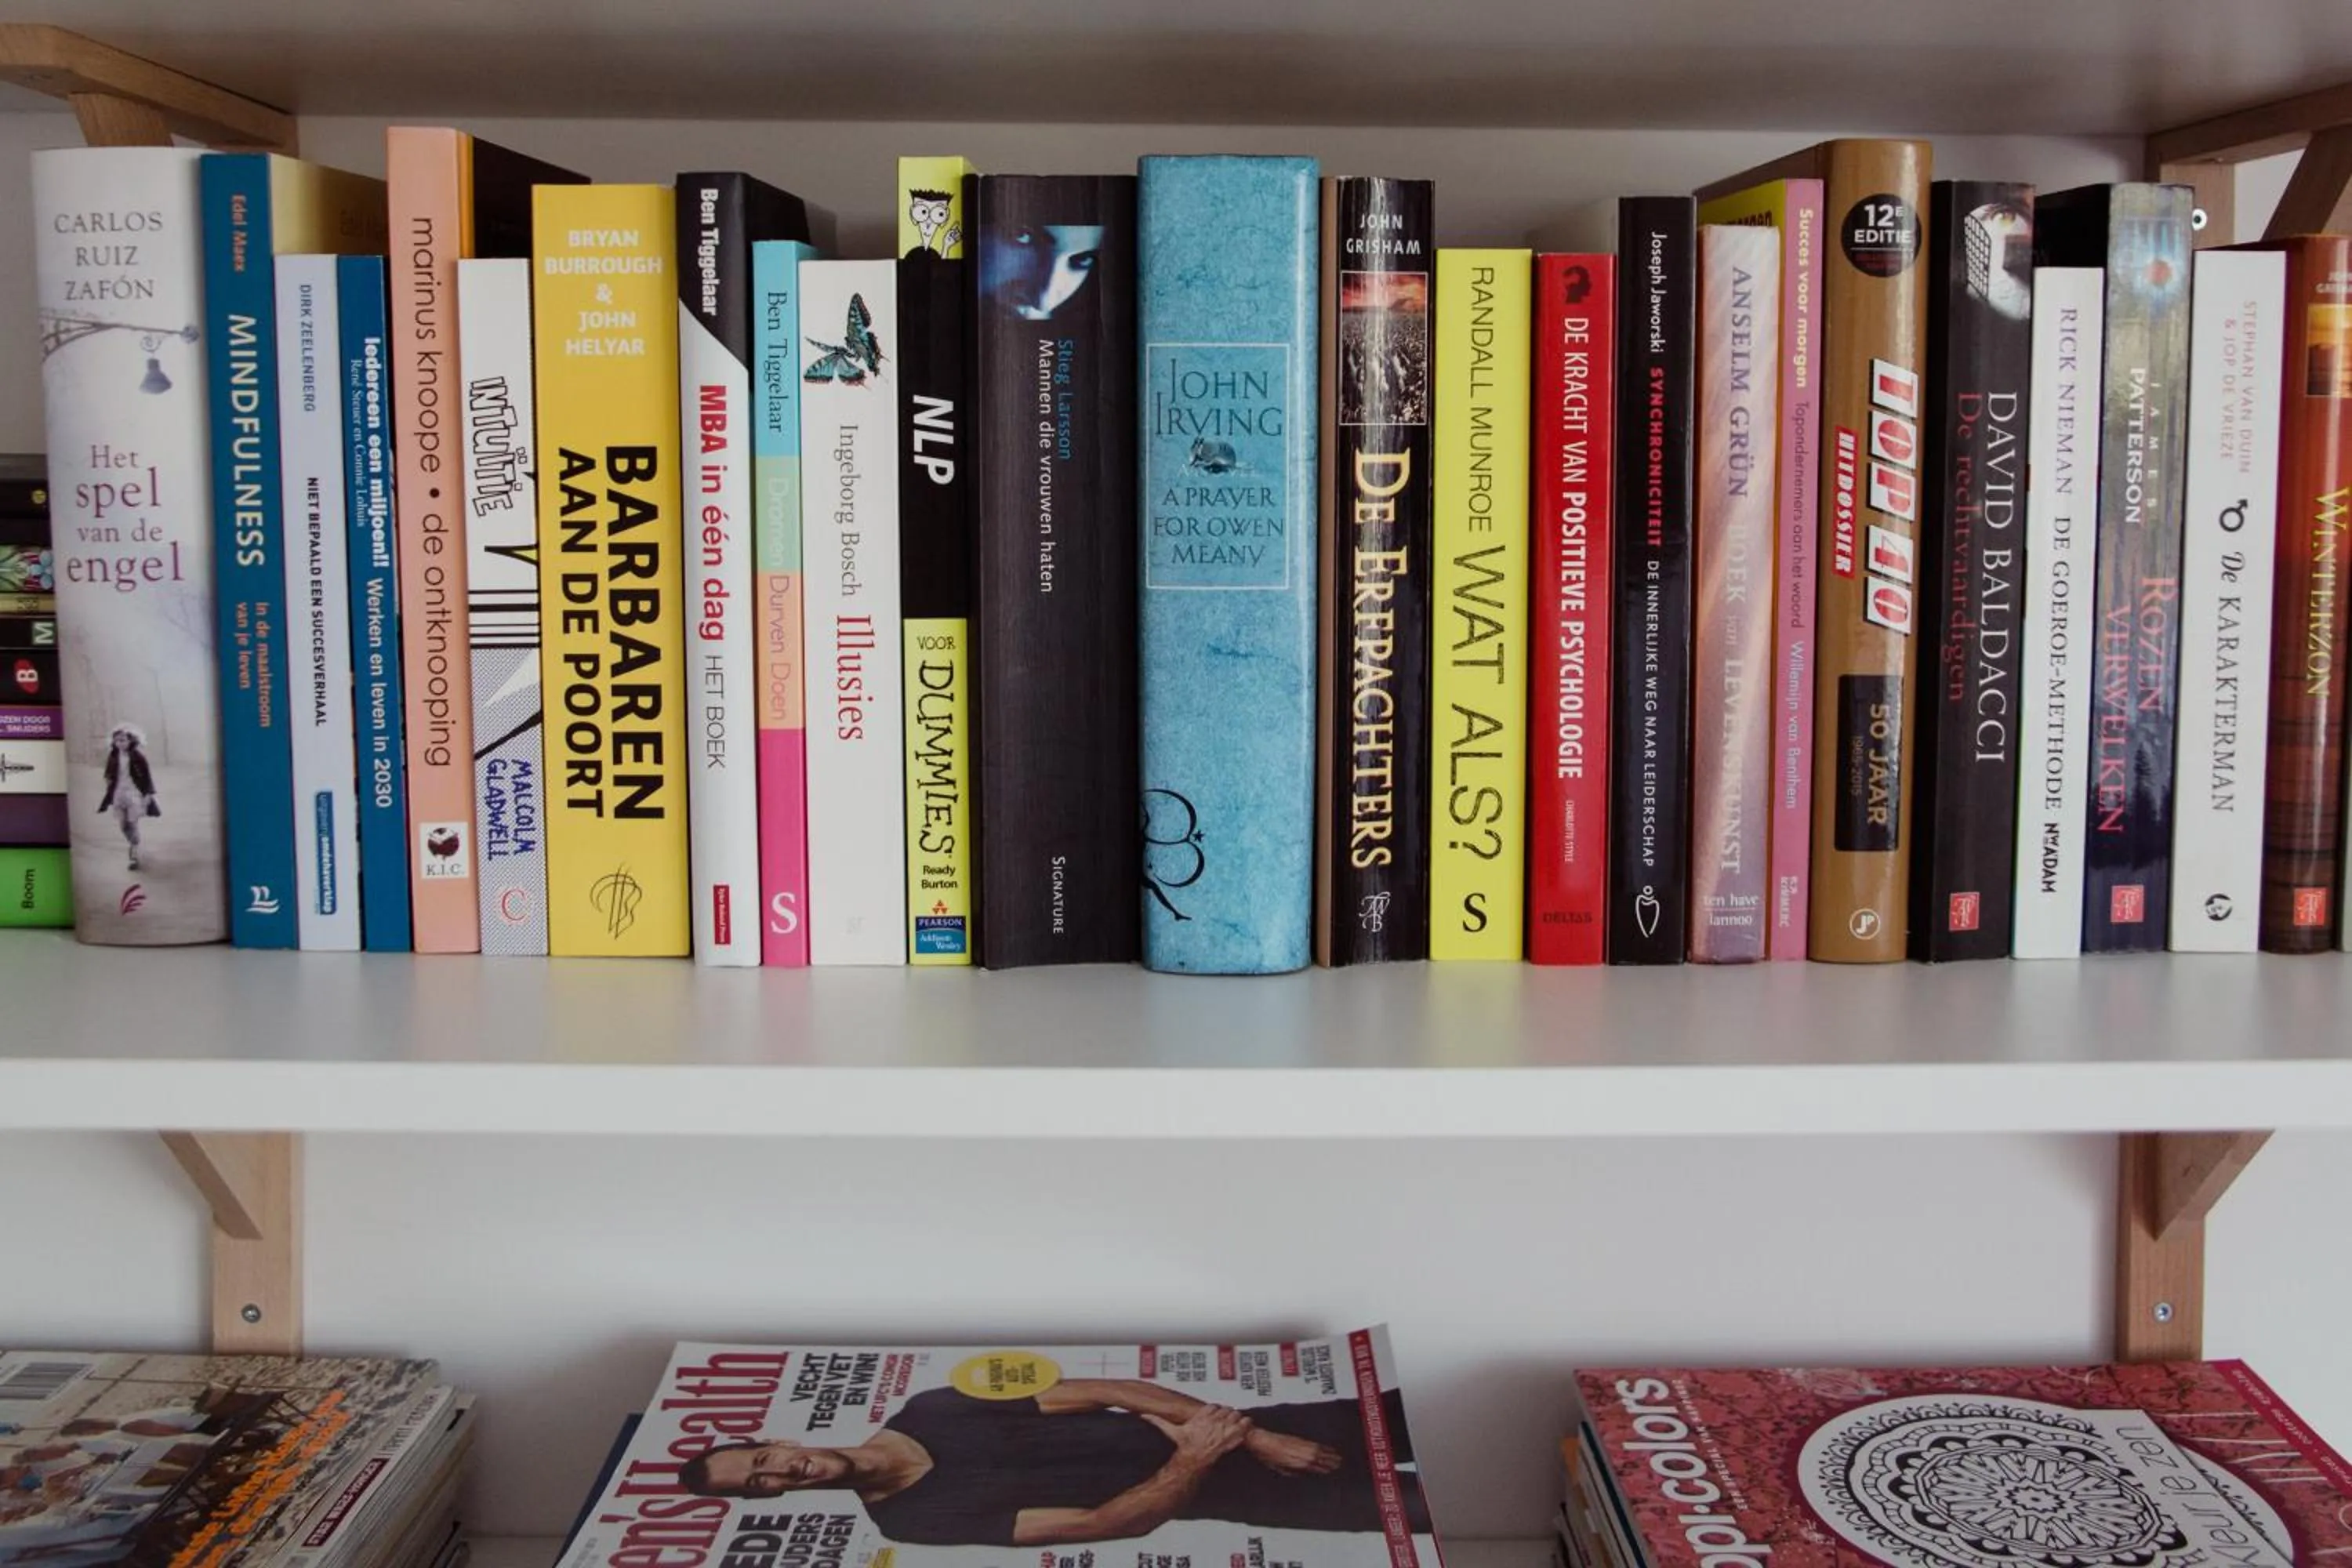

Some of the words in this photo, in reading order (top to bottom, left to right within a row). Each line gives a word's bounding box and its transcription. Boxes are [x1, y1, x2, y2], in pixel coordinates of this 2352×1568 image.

[54, 211, 164, 234] CARLOS
[700, 188, 719, 224] Ben
[1360, 214, 1403, 230] JOHN
[76, 245, 140, 267] RUIZ
[568, 230, 639, 247] BRYAN
[1345, 238, 1421, 255] GRISHAM
[1648, 231, 1667, 285] Joseph
[1798, 208, 1813, 265] Succes
[1853, 230, 1912, 244] EDITIE
[64, 277, 154, 301] ZAFÓN
[412, 218, 441, 339] marinus
[544, 256, 663, 274] BURROUGH
[698, 228, 720, 315] Tiggelaar
[299, 285, 313, 317] DIRK
[596, 283, 613, 304] &
[768, 292, 788, 330] Ben
[1798, 270, 1808, 313] voor
[579, 311, 636, 332] JOHN
[1469, 267, 1494, 398] RANDALL
[1563, 318, 1588, 343] DE
[1650, 287, 1667, 352] Jaworski
[1730, 267, 1752, 392] ANSELM
[2057, 307, 2078, 372] RICK
[2241, 300, 2258, 378] STEPHAN
[301, 321, 317, 412] ZEELENBERG
[565, 339, 645, 355] HELYAR
[1054, 339, 1073, 384] Stieg
[1793, 320, 1807, 388] morgen
[350, 359, 362, 387] René
[363, 337, 380, 429] Iedereen
[764, 338, 789, 432] Tiggelaar
[1039, 339, 1054, 414] Mannen
[1171, 358, 1268, 403] JOHN
[1563, 353, 1588, 434] KRACHT
[2221, 375, 2236, 394] DE
[414, 351, 442, 473] knoope
[700, 386, 728, 453] MBA
[1058, 393, 1073, 460] Larsson
[1155, 391, 1283, 437] IRVING
[1958, 393, 1982, 440] De
[2239, 387, 2255, 421] VAN
[91, 445, 140, 469] Het
[228, 314, 264, 566] MINDFULNESS
[353, 428, 362, 441] en
[368, 434, 382, 473] een
[913, 394, 955, 485] NLP
[1039, 421, 1055, 449] die
[1647, 368, 1664, 546] SYNCHRONICITEIT
[1728, 406, 1755, 497] GRÜN
[2055, 384, 2076, 495] NIEMAN
[2125, 368, 2147, 523] PATTERSON
[702, 466, 728, 493] in
[833, 426, 861, 523] Ingeborg
[1468, 408, 1494, 532] MUNROE
[1562, 440, 1588, 483] VAN
[1984, 392, 2017, 529] DAVID
[75, 466, 162, 518] spel
[307, 477, 320, 508] NIET
[558, 447, 598, 552] AAN
[1040, 455, 1052, 534] vrouwen
[1162, 488, 1180, 506] A
[1185, 487, 1276, 510] PRAYER
[1354, 447, 1410, 524] DE
[77, 526, 120, 543] van
[131, 518, 163, 543] de
[308, 513, 321, 575] BEPAALD
[369, 477, 390, 568] miljoen!!
[422, 514, 448, 555] de
[702, 506, 730, 566] één
[1153, 517, 1201, 536] FOR
[1207, 517, 1284, 536] OWEN
[1792, 521, 1805, 551] aan
[2053, 516, 2071, 550] DE
[67, 540, 185, 593] engel
[841, 533, 862, 596] Bosch
[1040, 542, 1056, 593] haten
[1171, 546, 1266, 568] MEANY
[1560, 492, 1587, 612] POSITIEVE
[1646, 561, 1660, 580] DE
[1791, 557, 1807, 579] het
[2220, 552, 2245, 583] De
[310, 579, 322, 607] EEN
[1942, 456, 1982, 701] rechtvaardigen
[2307, 487, 2350, 696] WINTERZON
[236, 601, 248, 627] van
[256, 601, 270, 615] In
[367, 578, 384, 648] Werken
[561, 573, 600, 634] DE
[699, 579, 730, 641] dag
[769, 575, 790, 653] Durven
[1451, 545, 1506, 684] WAT
[1790, 585, 1806, 628] woord
[234, 633, 249, 645] je
[256, 621, 271, 637] de
[606, 446, 665, 818] BARBAREN
[917, 636, 956, 650] VOOR
[1645, 586, 1660, 672] INNERLIJKE
[2136, 577, 2179, 711] ROZEN
[238, 651, 252, 688] leven
[311, 612, 327, 726] SUCCESVERHAAL
[369, 654, 383, 676] en
[423, 566, 456, 766] ontknooping
[705, 655, 724, 699] HET
[837, 615, 875, 740] Illusies
[1975, 549, 2013, 763] BALDACCI
[256, 642, 272, 728] maalstroom
[370, 682, 387, 730] leven
[771, 663, 791, 720] Doen
[1351, 546, 1408, 868] ERFPACHTERS
[1558, 621, 1585, 779] PSYCHOLOGIE
[1643, 677, 1657, 711] WEG
[2045, 561, 2071, 810] GOEROE-METHODE
[2211, 597, 2241, 812] KARAKTERMAN
[564, 654, 604, 818] POORT
[706, 706, 725, 768] BOEK
[1643, 716, 1657, 759] NAAR
[1785, 715, 1798, 742] van
[1871, 704, 1889, 738] 50
[2097, 604, 2131, 833] VERWELKEN
[373, 736, 389, 752] in
[915, 660, 958, 854] DUMMIES
[374, 758, 392, 807] 2030
[1448, 702, 1504, 860] ALS?
[1784, 746, 1801, 809] Benthem
[1867, 746, 1888, 826] JAAR
[483, 758, 510, 861] GLADWELL
[511, 759, 536, 855] MALCOLM
[1642, 764, 1657, 866] LEIDERSCHAP
[21, 868, 36, 909] Boom
[426, 864, 464, 876] K.I.C.
[921, 880, 958, 890] Burton
[923, 865, 956, 877] Ready
[771, 892, 797, 933] S
[1051, 855, 1065, 935] SIGNATURE
[1462, 893, 1488, 933] S
[1730, 893, 1759, 906] have
[918, 918, 962, 927] PEARSON
[1709, 913, 1753, 927] lannoo
[789, 1352, 828, 1402] VECHT
[822, 1352, 854, 1384] VET
[850, 1352, 880, 1384] WIN!
[806, 1384, 842, 1432] TEGEN
[842, 1385, 867, 1406] EN
[867, 1404, 885, 1423] MET
[2115, 1426, 2180, 1468] zen
